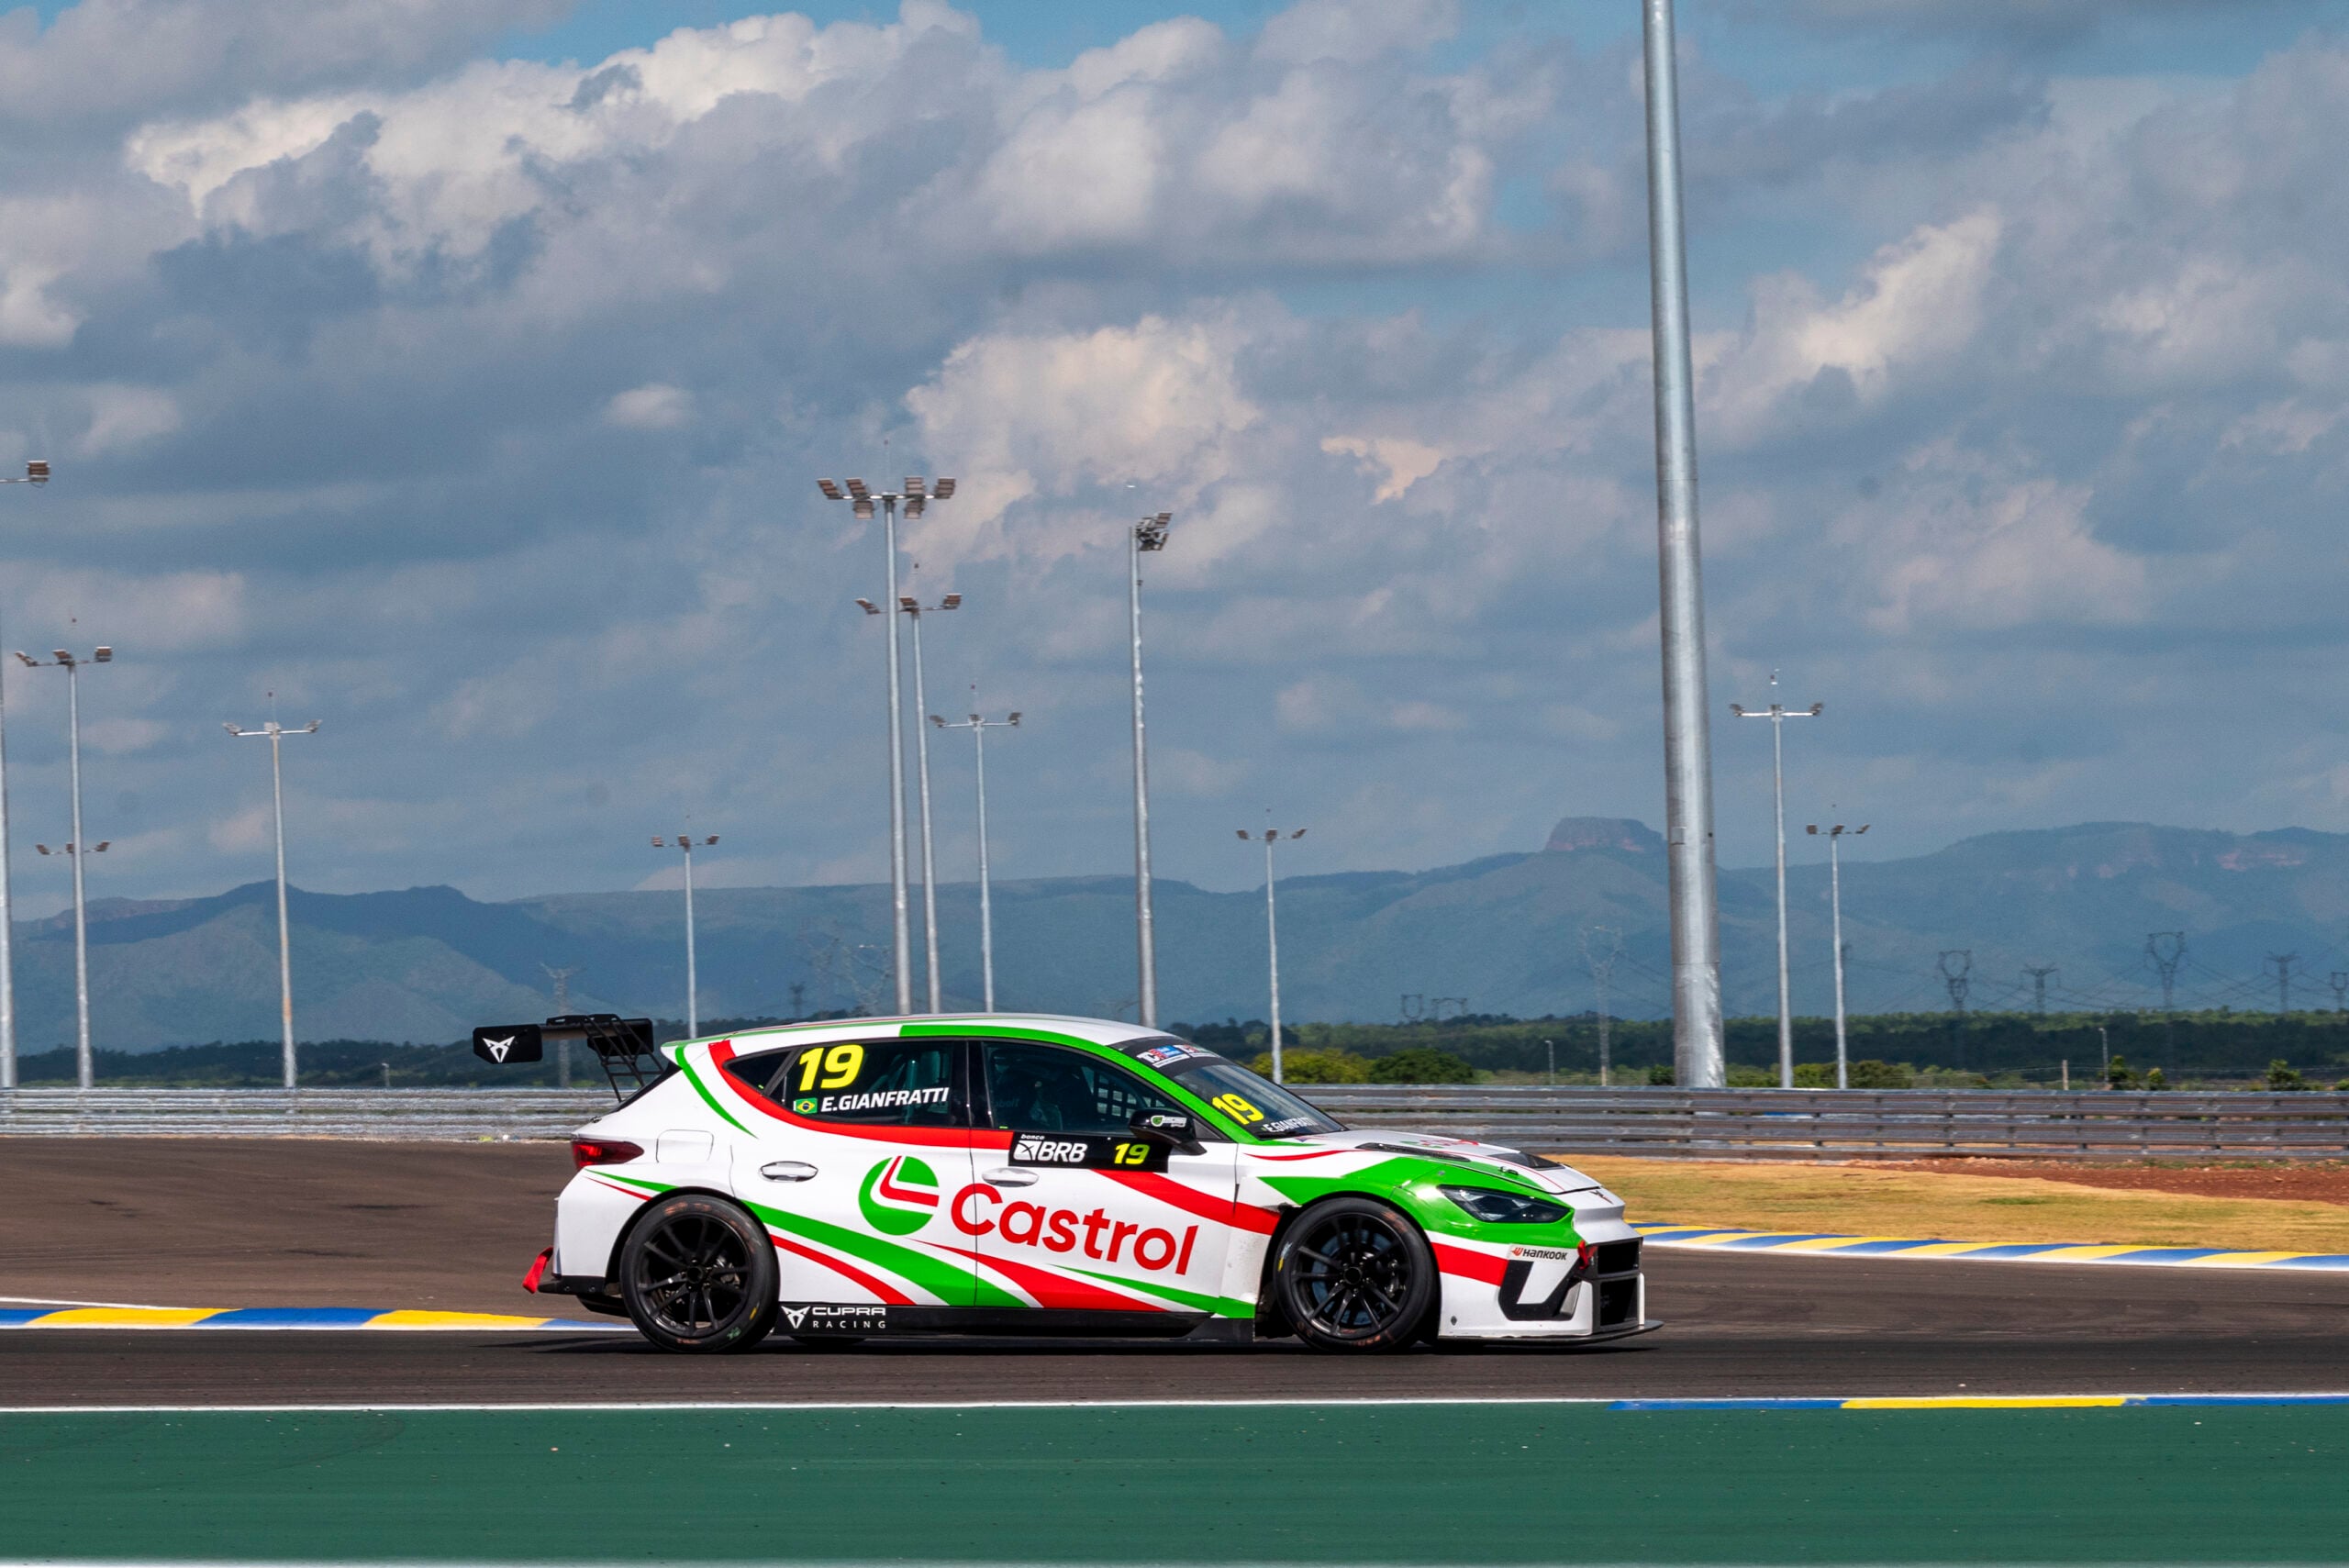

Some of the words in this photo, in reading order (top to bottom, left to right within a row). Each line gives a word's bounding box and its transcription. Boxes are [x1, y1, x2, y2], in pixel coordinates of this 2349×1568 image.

[799, 1044, 863, 1091] 19
[821, 1087, 950, 1112] E.GIANFRATTI
[1211, 1093, 1264, 1125] 19
[1038, 1141, 1088, 1162] BRB
[1114, 1143, 1150, 1165] 19
[951, 1183, 1198, 1275] Castrol
[812, 1307, 886, 1316] CUPRA
[812, 1320, 886, 1329] RACING
